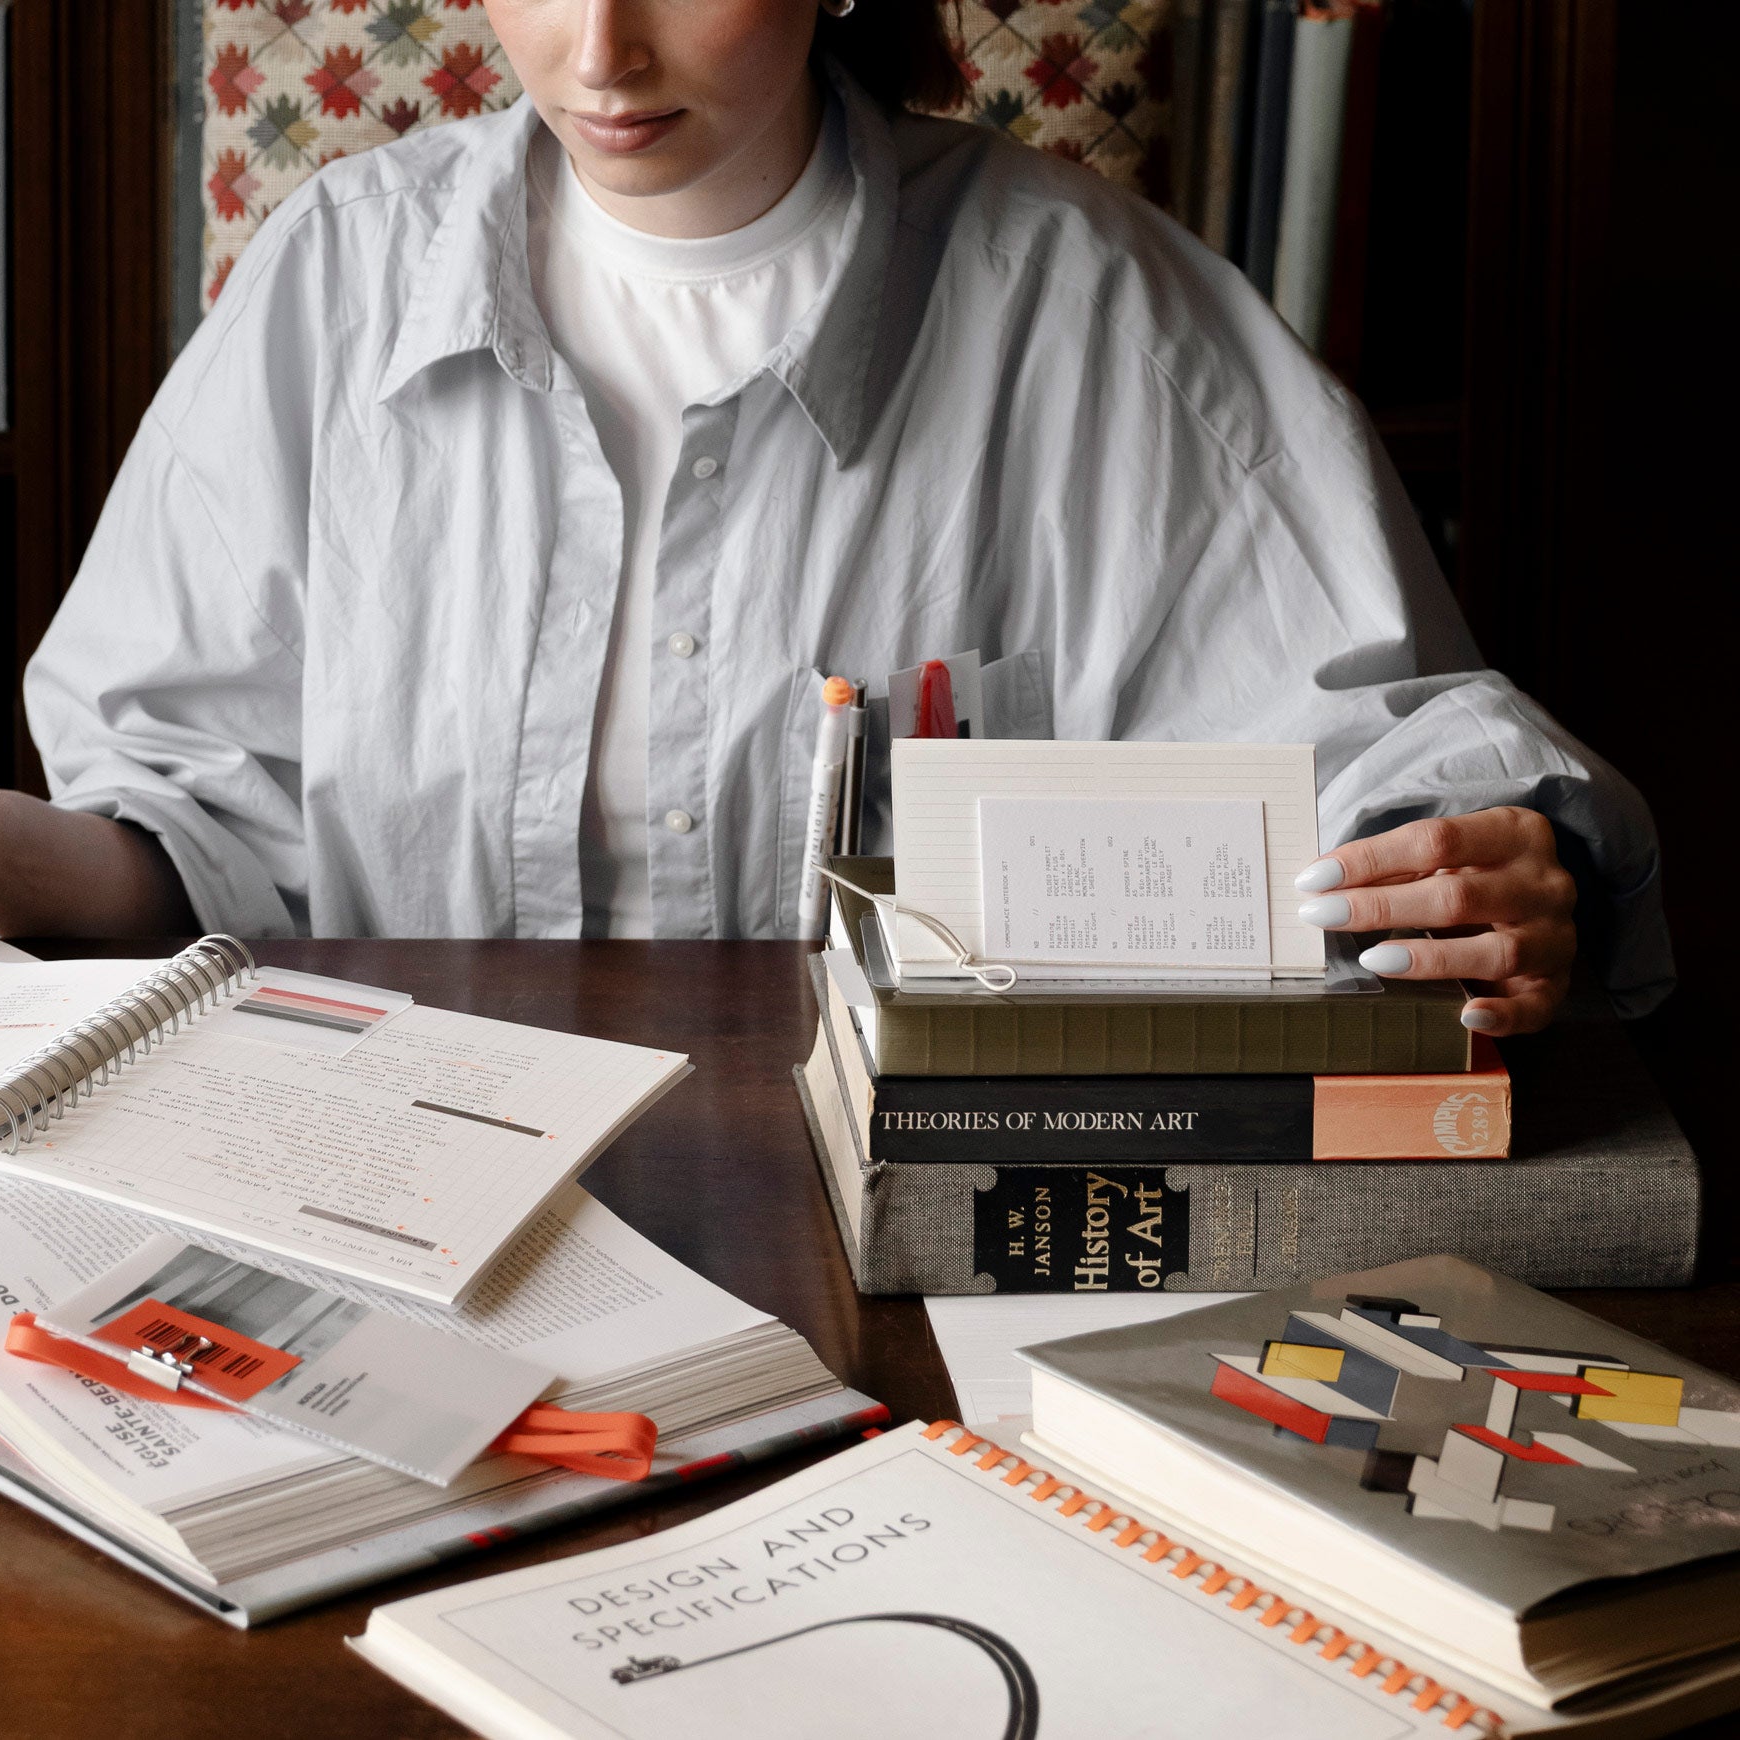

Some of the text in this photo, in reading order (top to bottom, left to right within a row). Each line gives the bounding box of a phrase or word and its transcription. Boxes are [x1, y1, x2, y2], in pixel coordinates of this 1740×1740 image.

[1003, 907, 1011, 949] COMMONPLACE
[878, 1112, 1198, 1131] THEORIES OF MODERN ART
[1433, 1092, 1490, 1155] CAMPUS
[1471, 1105, 1490, 1142] 289
[339, 1216, 430, 1247] PLANNING THEME
[1009, 1206, 1025, 1256] H. W.
[1034, 1186, 1052, 1276] JANSON
[1074, 1171, 1129, 1291] History
[1126, 1182, 1163, 1288] of Art
[105, 1423, 170, 1468] ÉGLISE
[567, 1506, 855, 1616] DESIGN AND
[571, 1512, 932, 1651] SPECIFICATIONS
